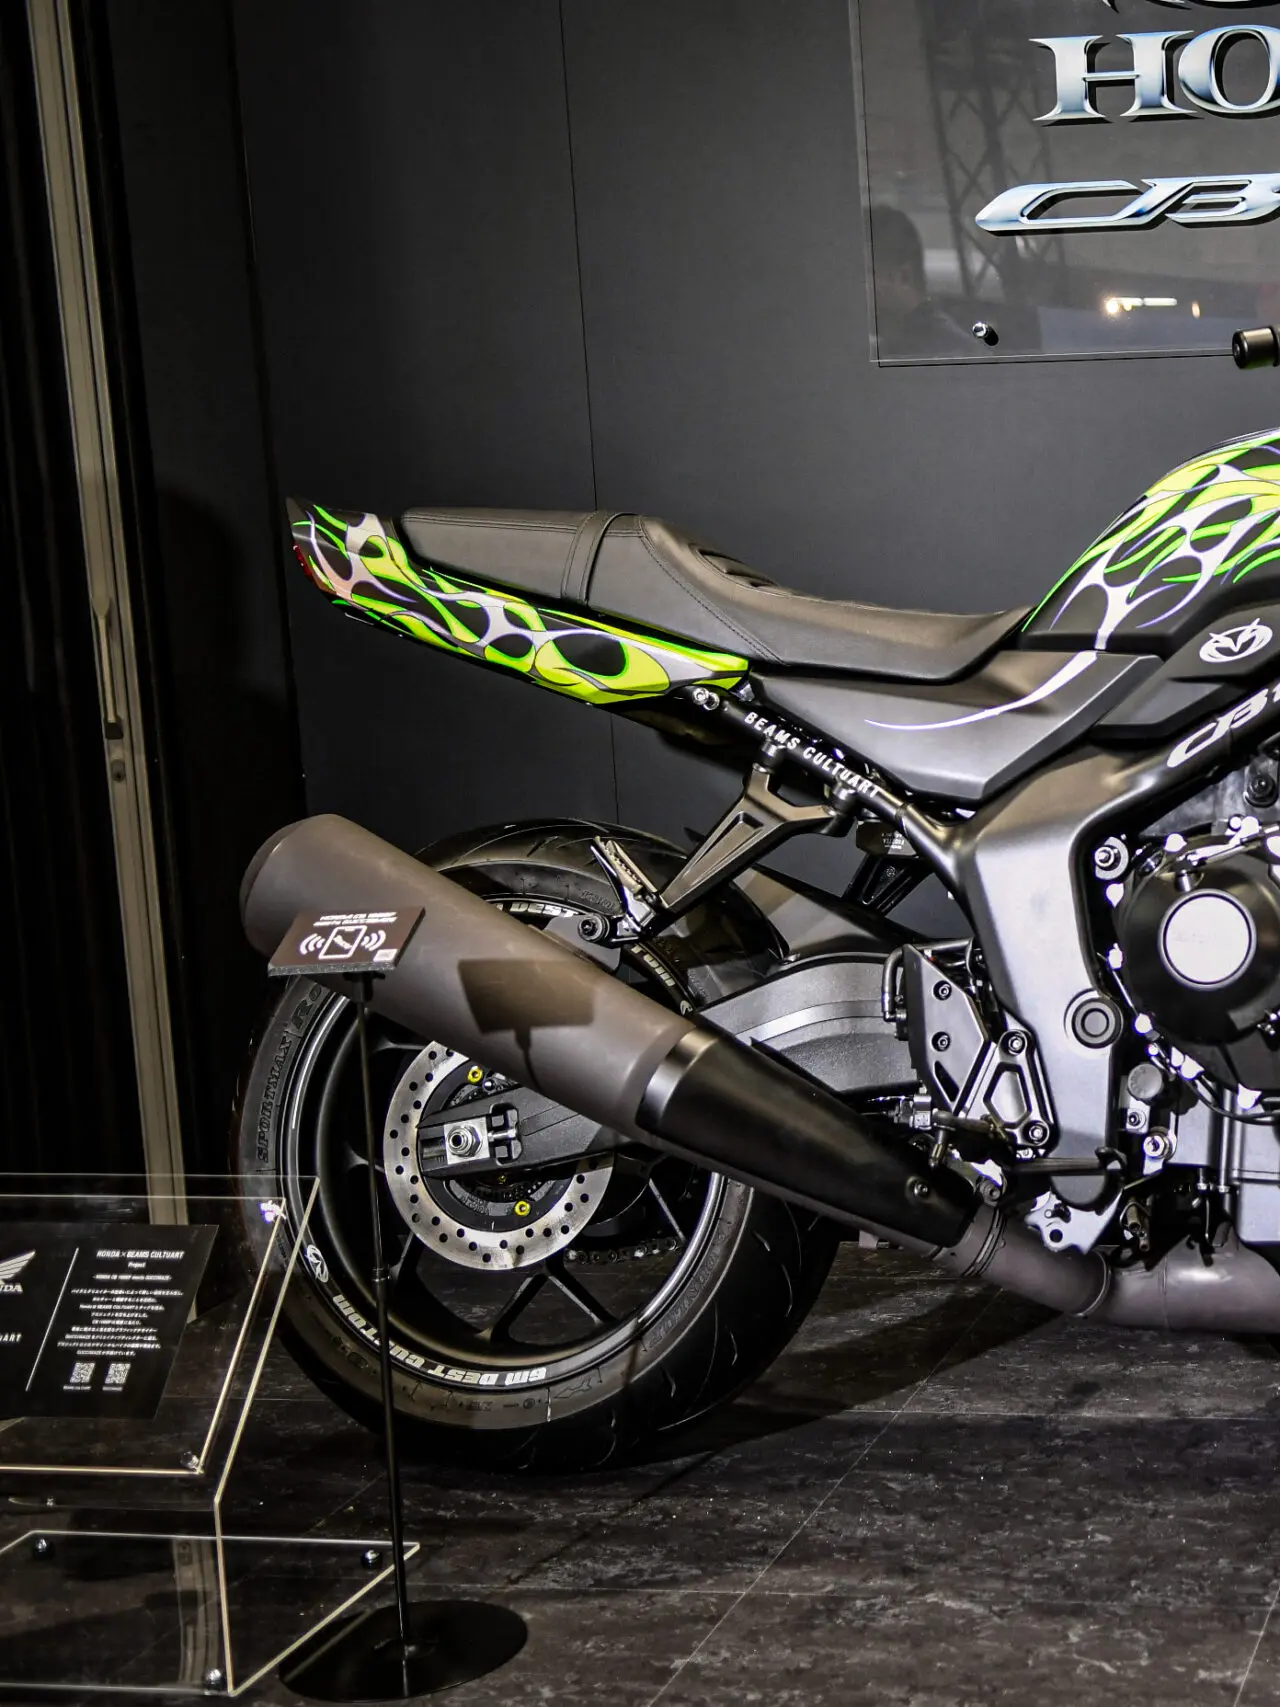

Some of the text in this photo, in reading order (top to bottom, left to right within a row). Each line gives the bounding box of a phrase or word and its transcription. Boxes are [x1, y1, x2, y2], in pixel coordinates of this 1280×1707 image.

[744, 711, 884, 798] BEAMS CULTUART
[257, 1034, 293, 1163] SPORTMAX
[127, 1250, 150, 1258] BEAMS
